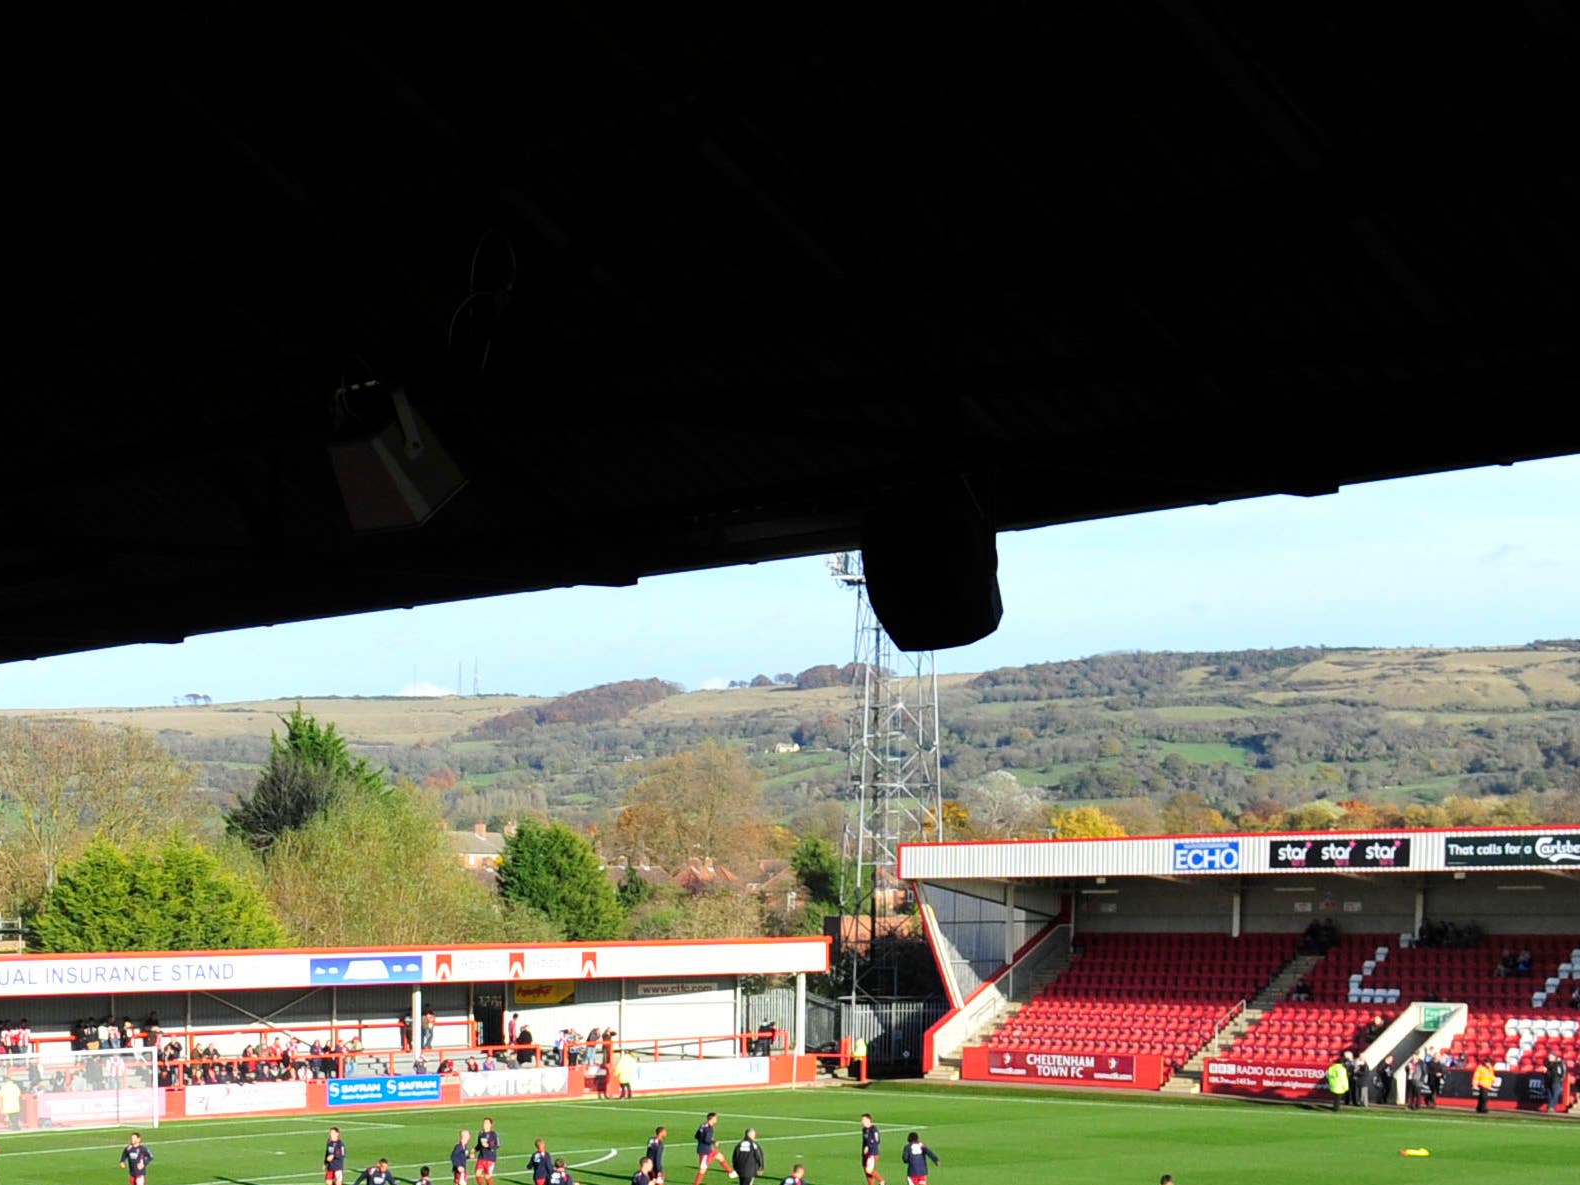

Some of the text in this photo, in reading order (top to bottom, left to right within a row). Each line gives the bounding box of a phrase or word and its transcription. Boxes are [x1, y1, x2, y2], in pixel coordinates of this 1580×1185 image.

[1278, 842, 1308, 861] star
[1321, 842, 1352, 860] star
[1365, 841, 1396, 860] star
[1448, 844, 1474, 855] That
[1477, 843, 1502, 855] calls
[1505, 843, 1521, 854] for
[1524, 845, 1532, 854] a
[1175, 849, 1239, 869] ECHO
[46, 965, 163, 984] INSURANCE
[171, 963, 234, 981] STAND
[1026, 1053, 1095, 1068] CHELTENHAM
[1036, 1065, 1084, 1078] TOWN FC
[1236, 1065, 1264, 1075] RADIO
[341, 1083, 381, 1093] SAFRAN
[398, 1080, 437, 1091] SAFRAN
